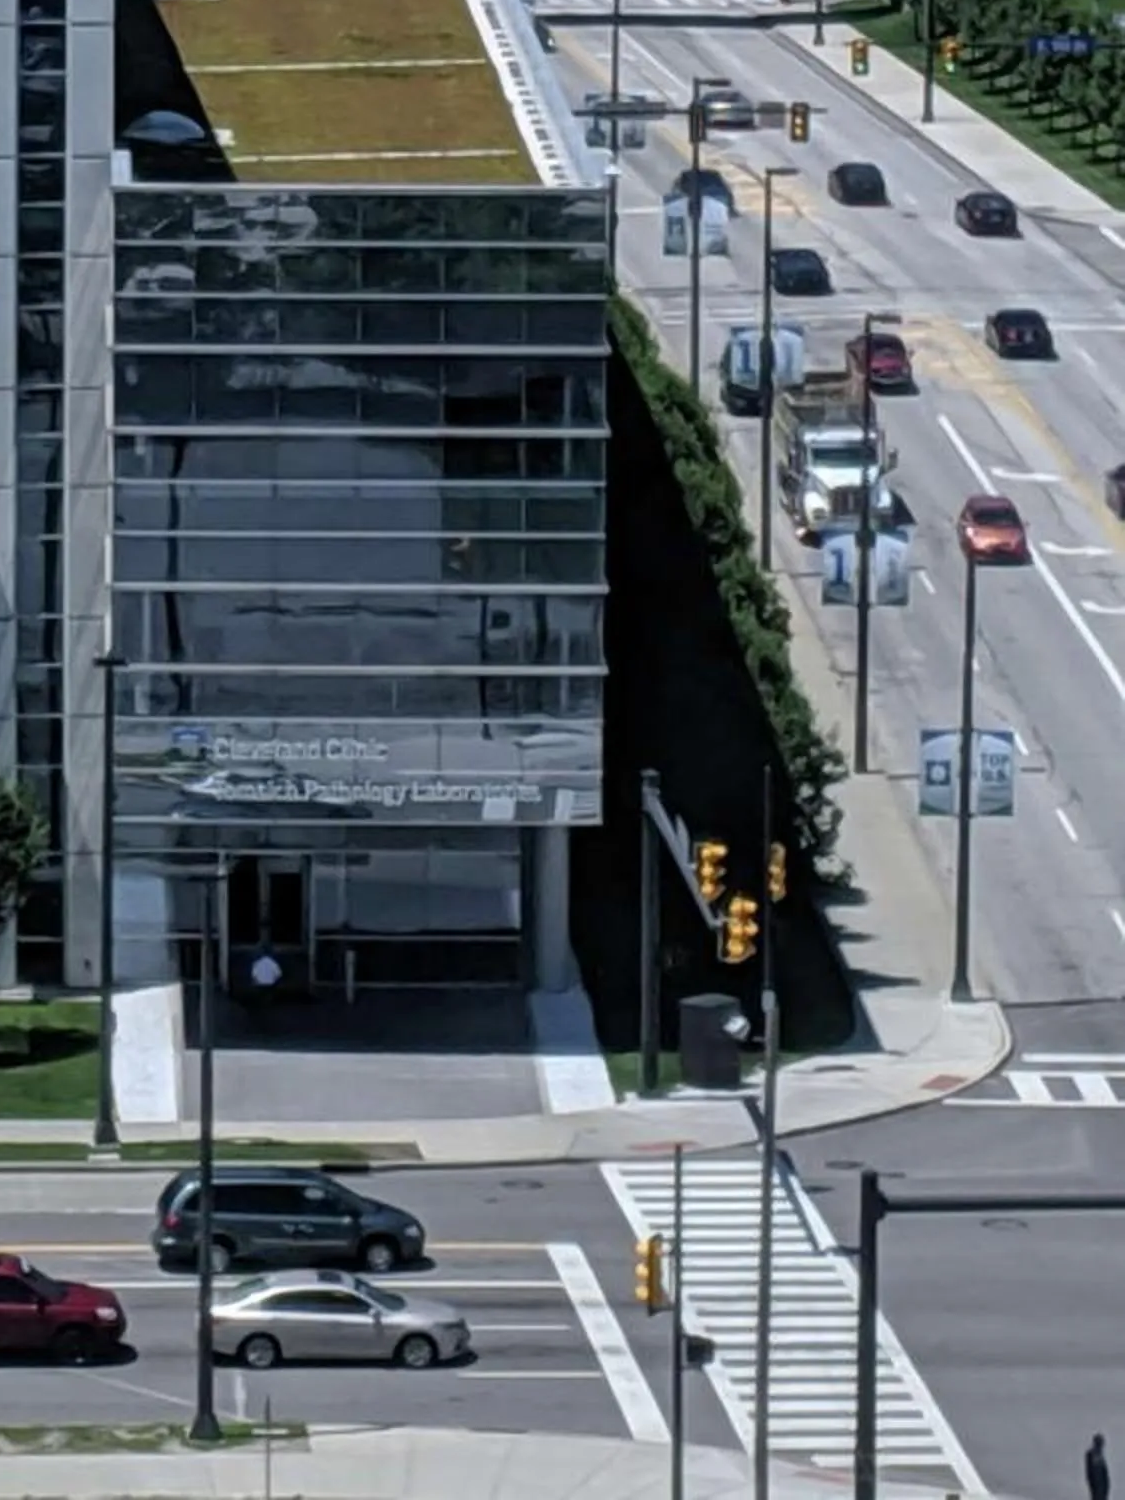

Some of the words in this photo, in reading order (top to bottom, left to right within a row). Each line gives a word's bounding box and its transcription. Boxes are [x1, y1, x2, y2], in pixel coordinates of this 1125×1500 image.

[214, 738, 322, 761] Cleveland
[326, 737, 391, 761] Clinic
[304, 779, 407, 807] Pathology
